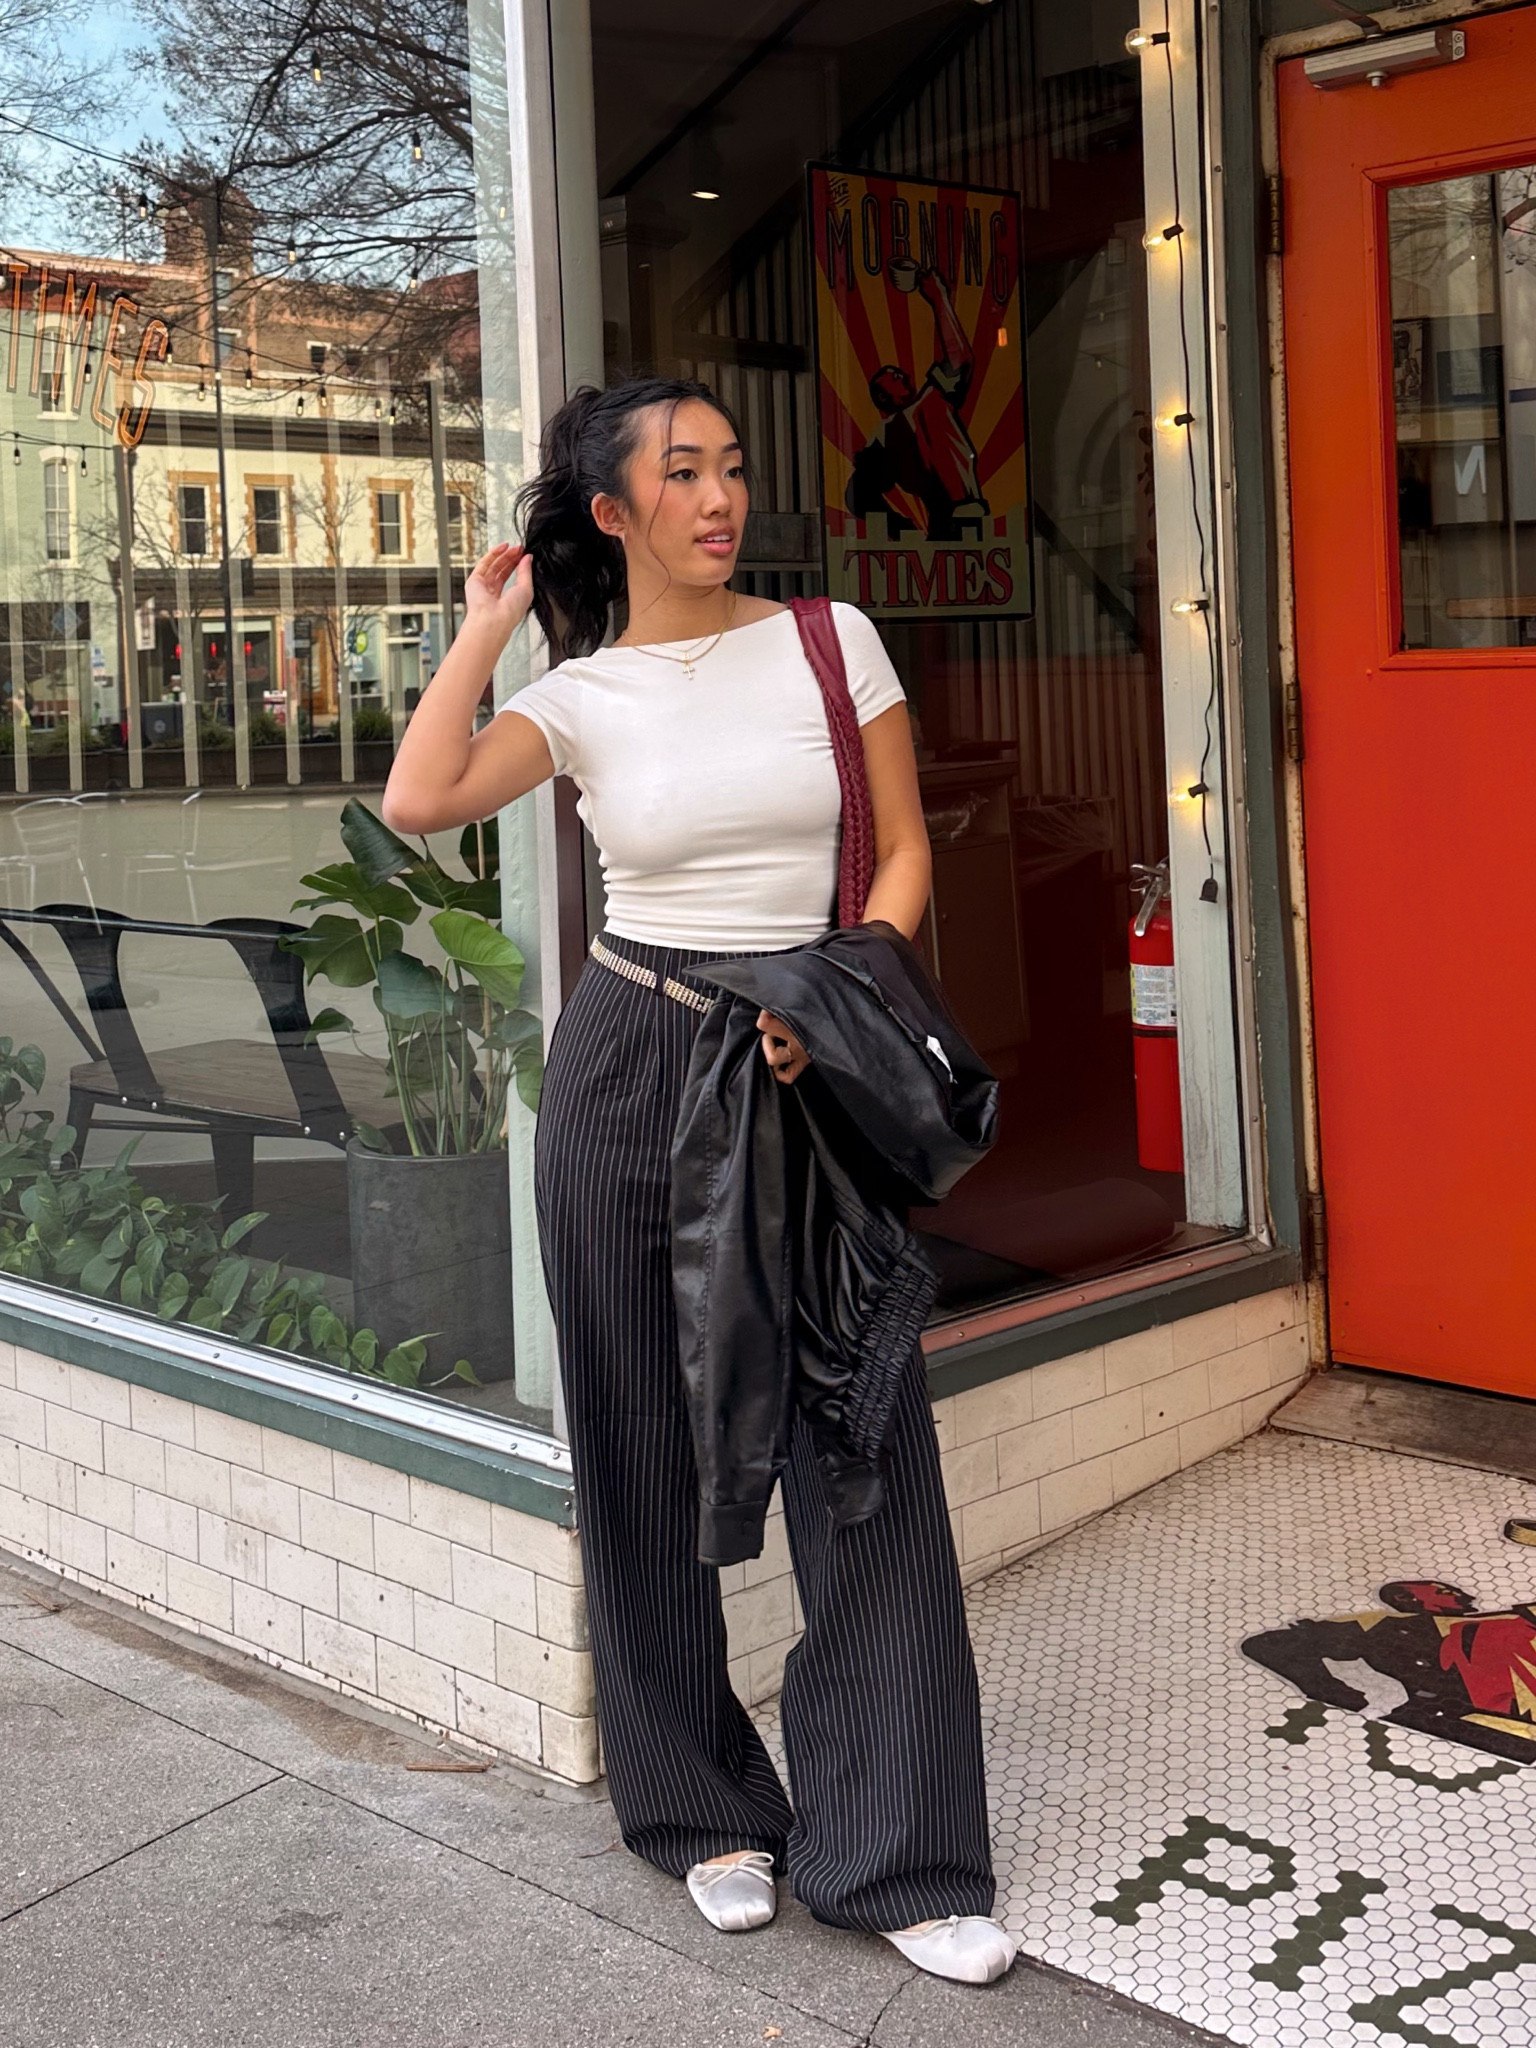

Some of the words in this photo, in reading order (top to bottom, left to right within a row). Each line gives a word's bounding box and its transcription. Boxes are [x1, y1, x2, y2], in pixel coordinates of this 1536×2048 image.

[825, 192, 1009, 305] MORNING
[7, 264, 169, 446] TIMES
[842, 547, 1014, 607] TIMES
